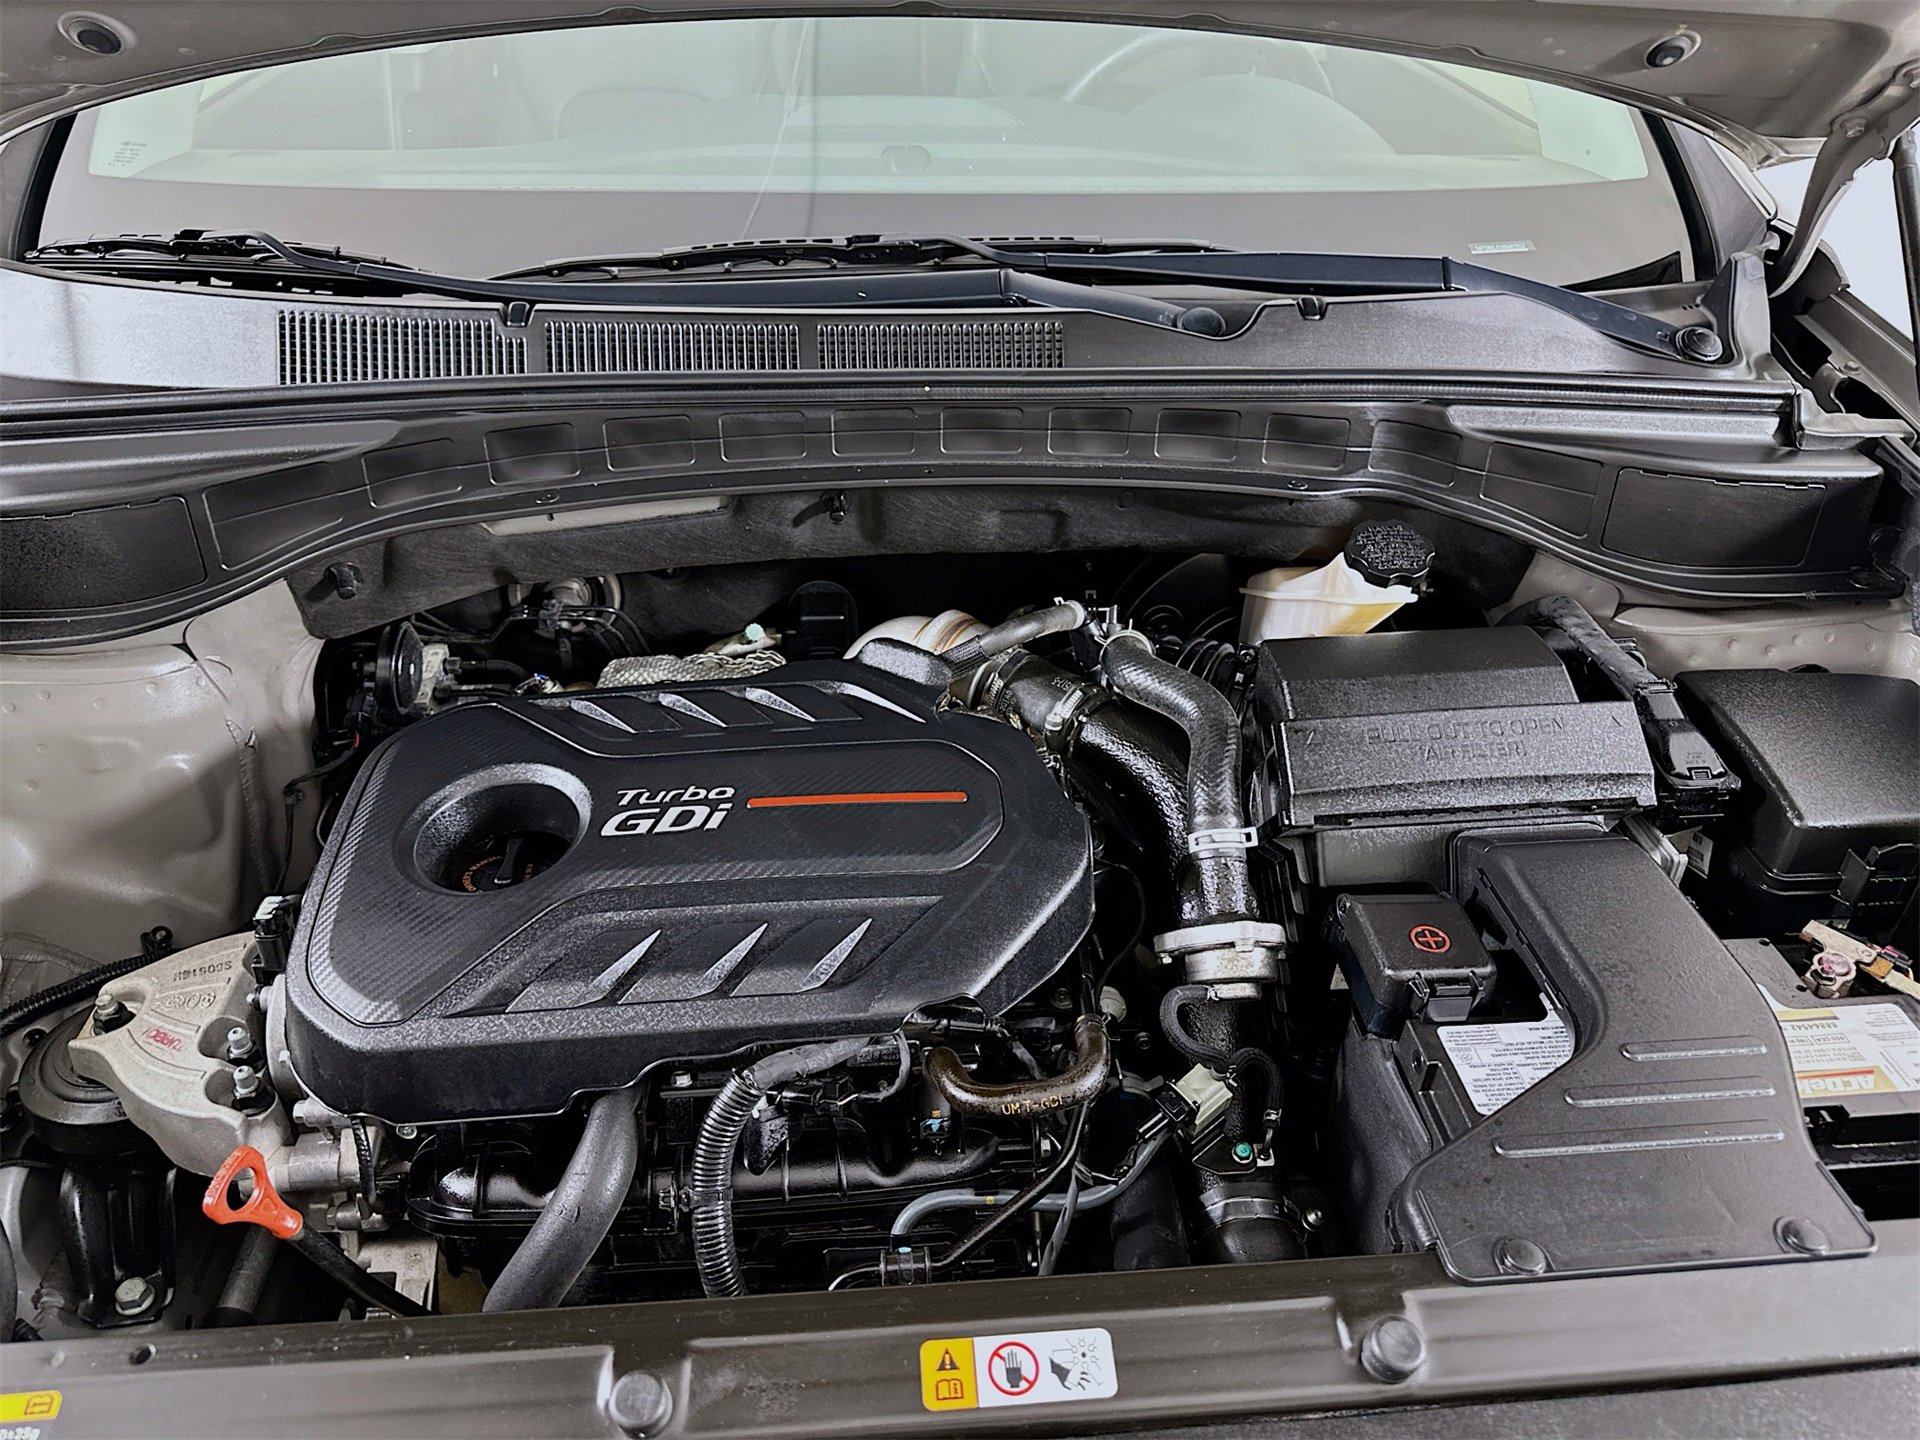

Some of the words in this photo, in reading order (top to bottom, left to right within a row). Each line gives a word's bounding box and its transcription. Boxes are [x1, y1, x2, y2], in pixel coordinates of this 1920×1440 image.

[1366, 726, 1422, 745] PULL
[1426, 722, 1472, 741] OUT
[1476, 720, 1505, 737] TO
[1510, 716, 1564, 736] OPEN
[617, 785, 735, 806] Turbo
[600, 803, 733, 836] GDi
[1001, 1101, 1021, 1116] UM
